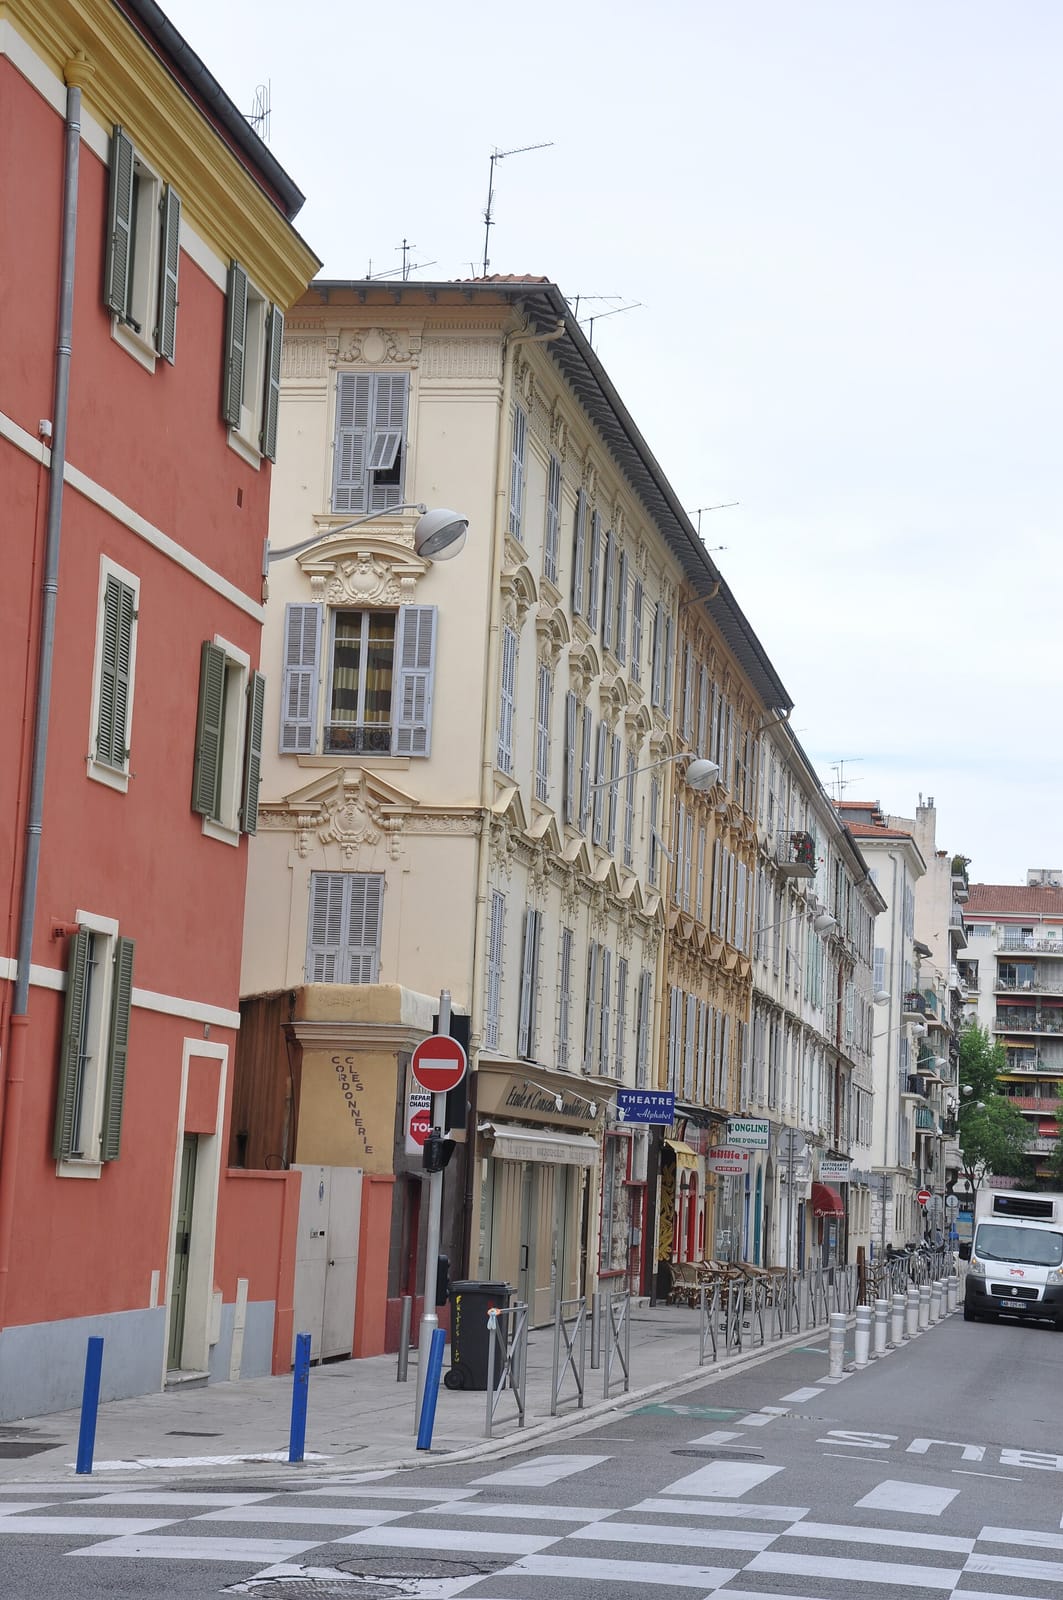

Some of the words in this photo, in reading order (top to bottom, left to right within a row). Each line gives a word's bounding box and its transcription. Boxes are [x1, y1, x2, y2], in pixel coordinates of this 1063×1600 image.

[345, 1056, 364, 1091] CLES
[331, 1056, 373, 1154] CORDONNERIE
[621, 1095, 672, 1106] THEATRE
[816, 1430, 1063, 1472] BUS
